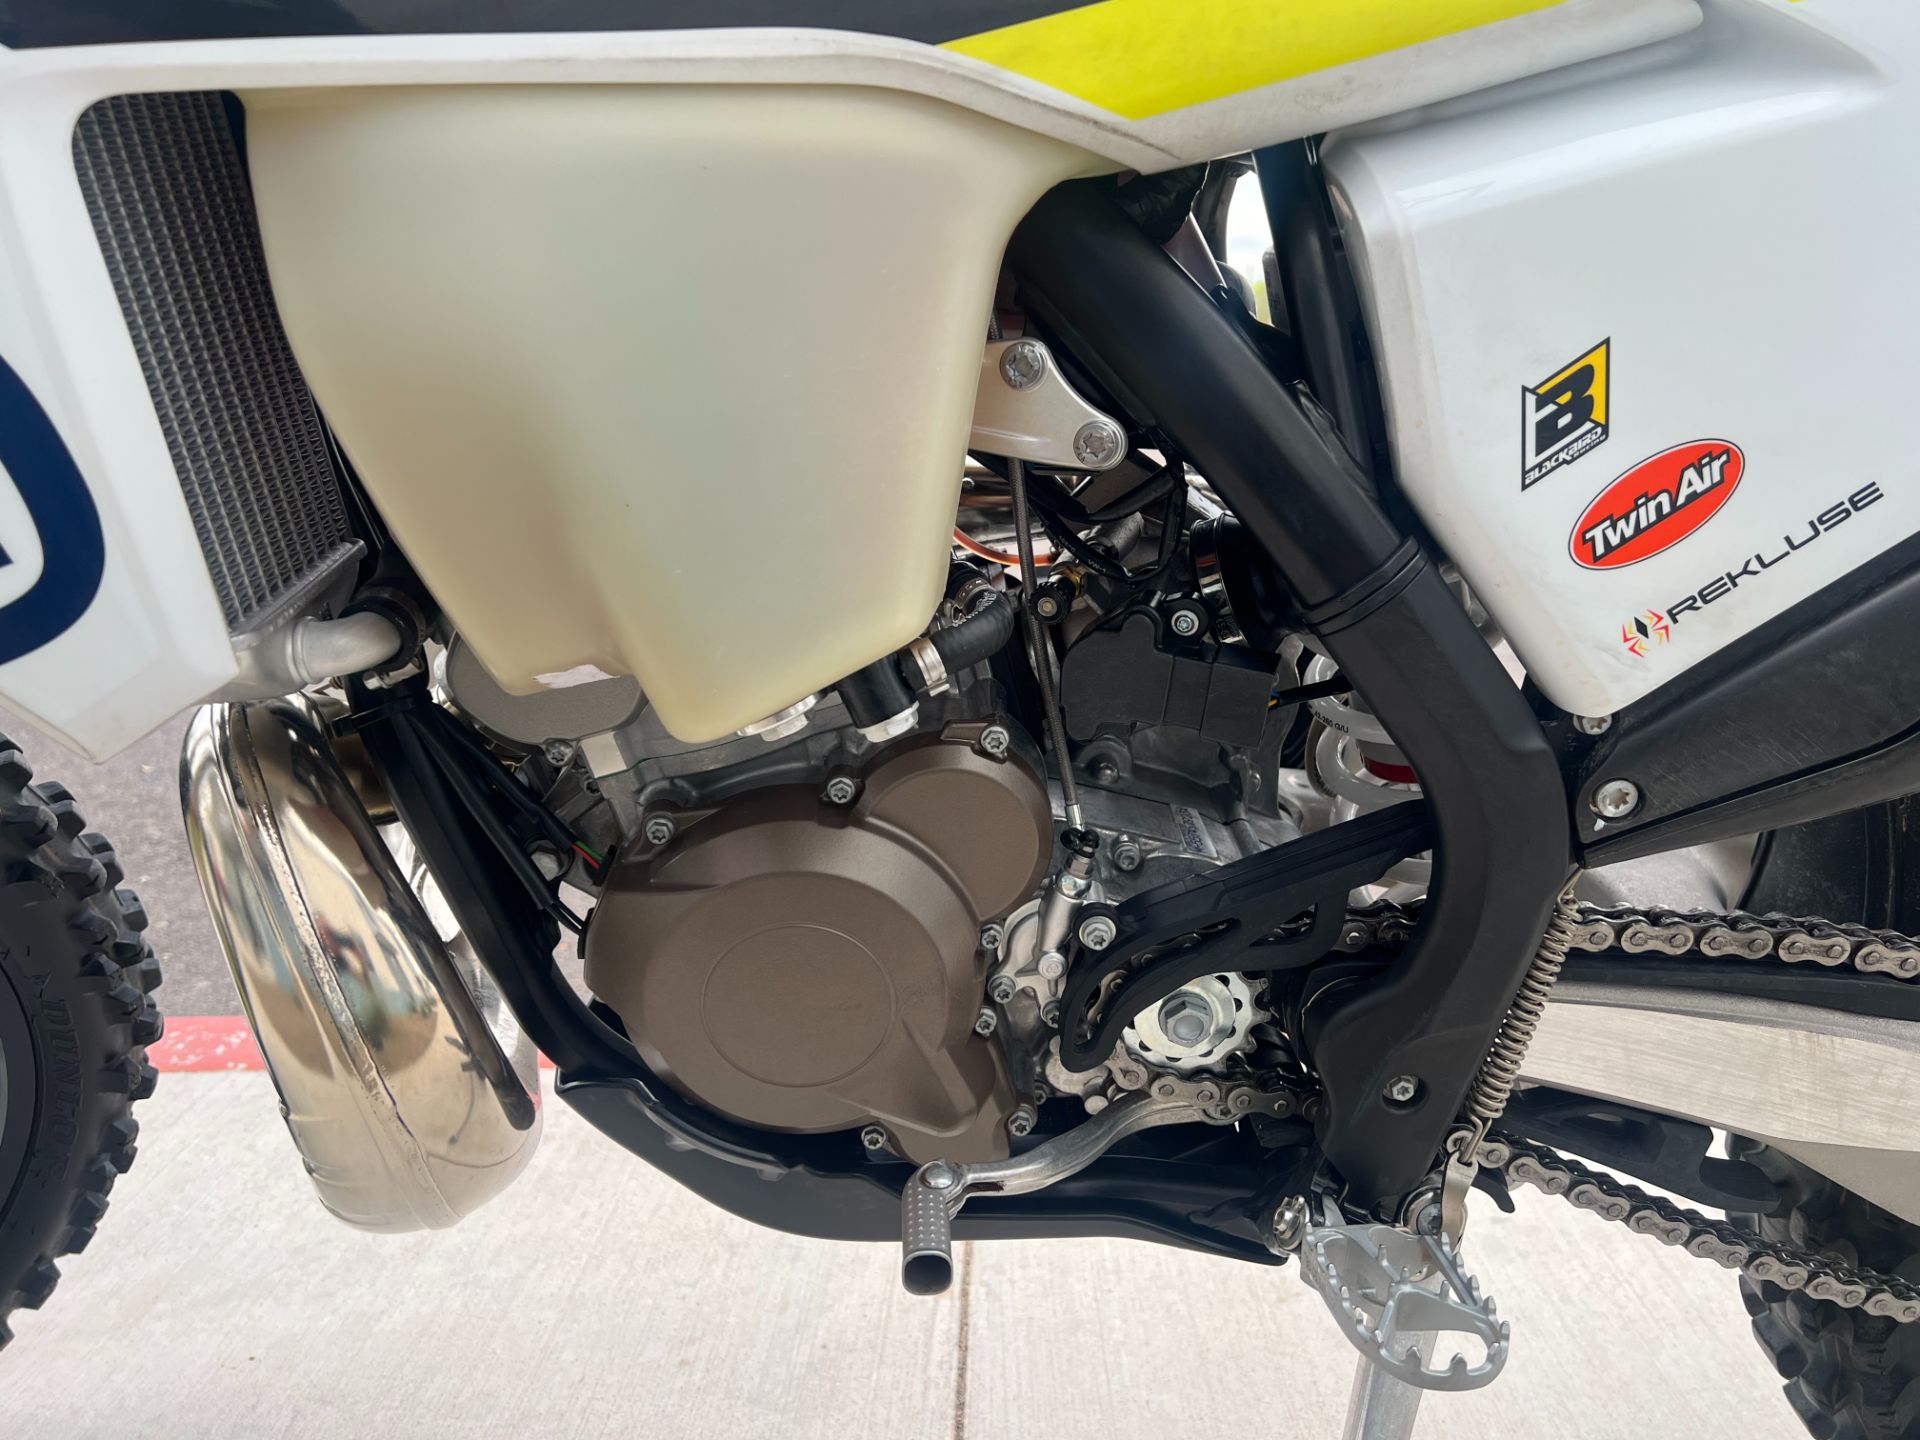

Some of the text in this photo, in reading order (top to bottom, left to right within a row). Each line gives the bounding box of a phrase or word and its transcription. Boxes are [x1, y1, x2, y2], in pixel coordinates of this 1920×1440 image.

[1583, 447, 1731, 561] Twin Air
[1666, 481, 1885, 624] REKLUSE
